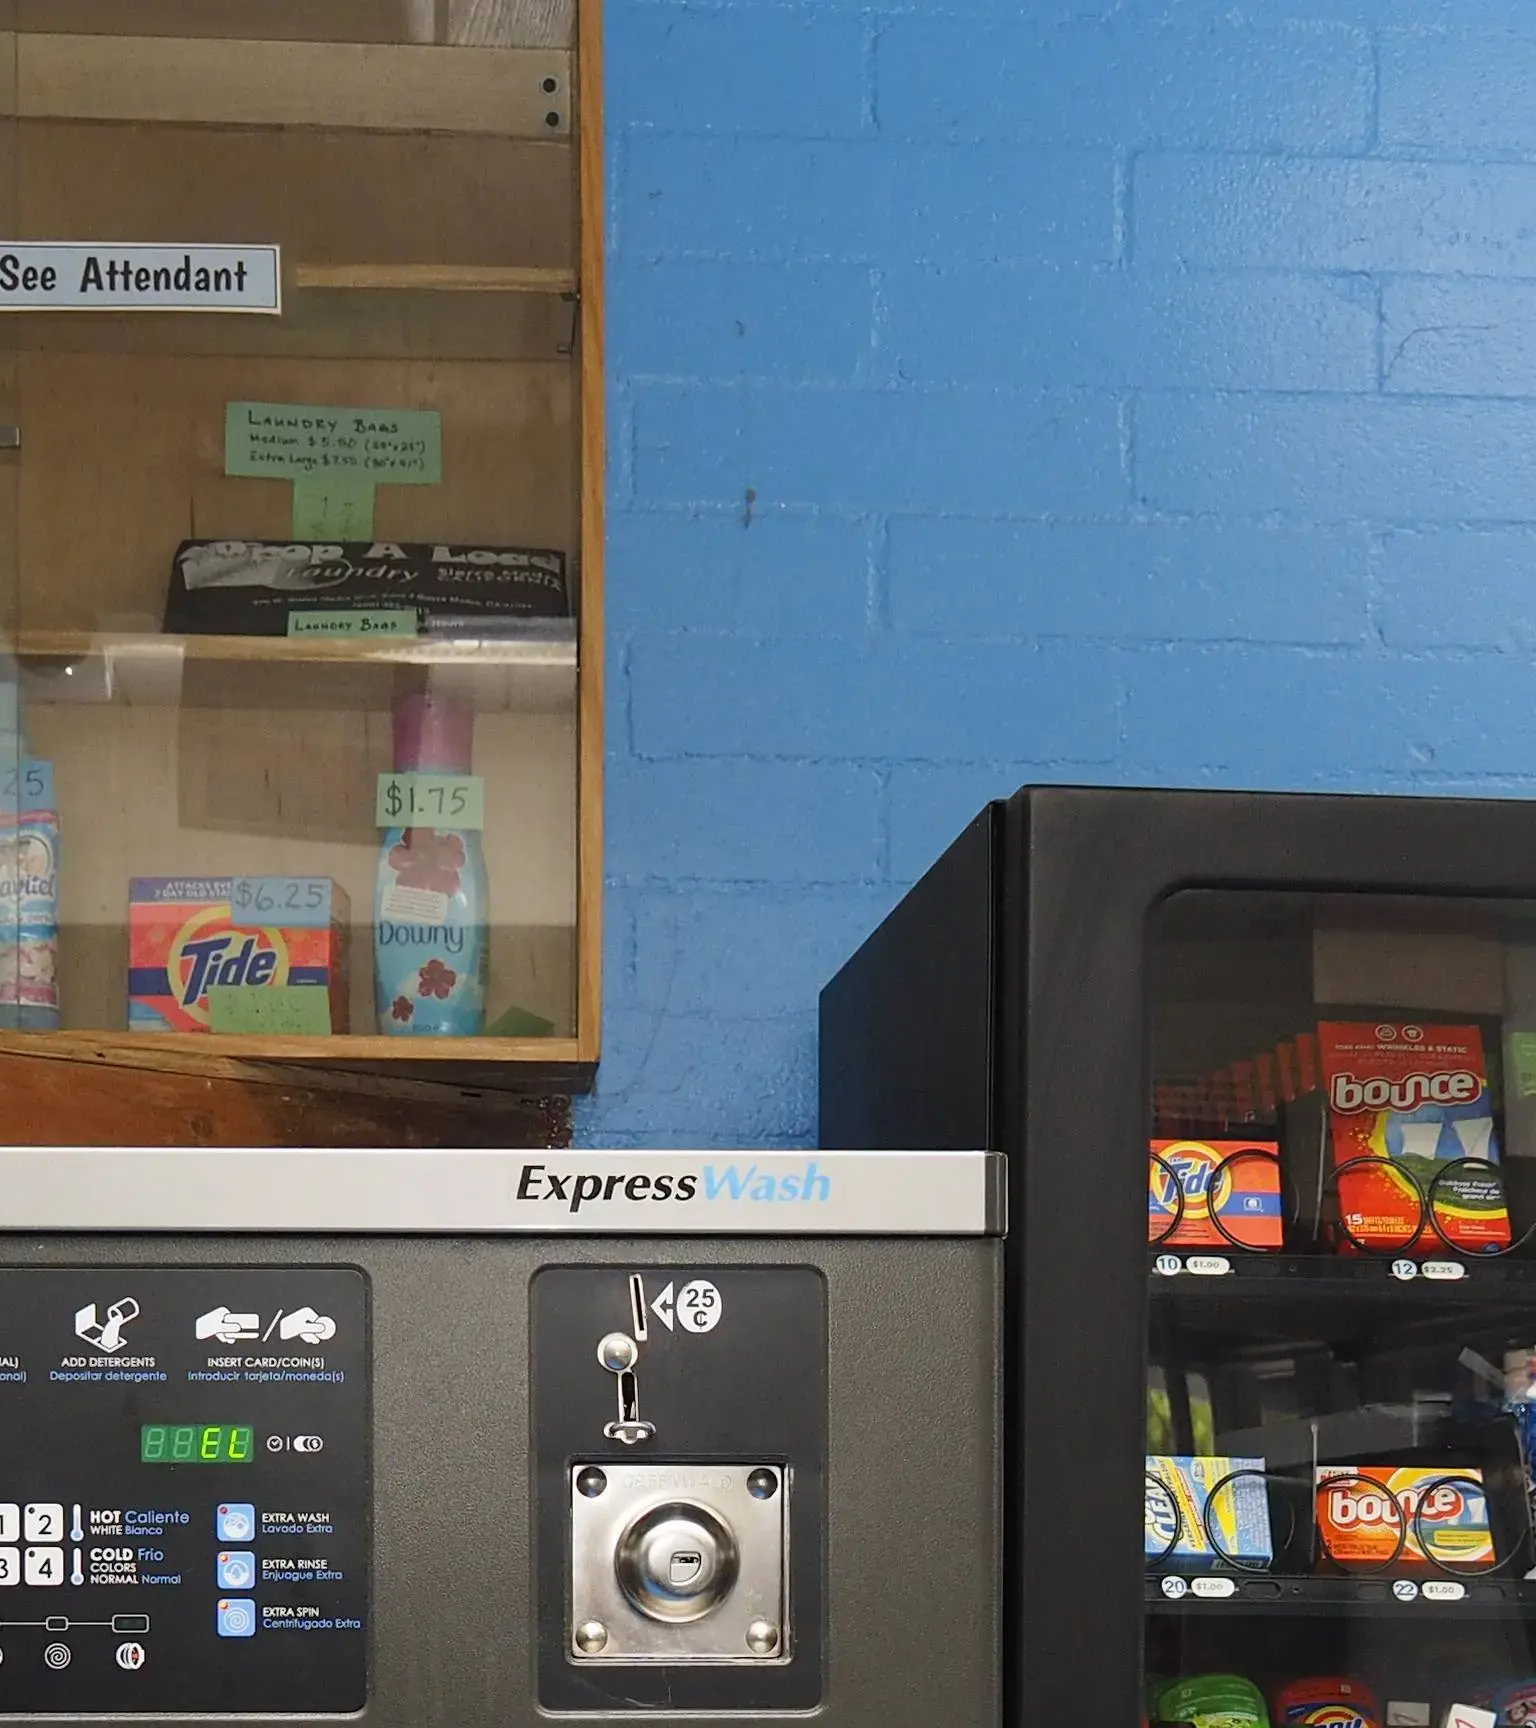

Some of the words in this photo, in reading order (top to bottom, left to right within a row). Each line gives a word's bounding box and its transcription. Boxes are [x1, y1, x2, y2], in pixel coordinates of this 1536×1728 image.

[80, 256, 247, 293] Attendant
[385, 780, 469, 817] $1.75
[235, 881, 328, 913] $6.25
[379, 922, 465, 954] Downy
[180, 934, 276, 1007] Tide
[1332, 1072, 1476, 1110] bounce
[1157, 1258, 1176, 1271] 10
[1395, 1263, 1413, 1275] 12
[685, 1288, 715, 1309] 25
[208, 1357, 242, 1368] INSERT
[90, 1510, 121, 1524] HOT
[125, 1510, 190, 1524] Caliente
[1331, 1487, 1460, 1526] bounce
[38, 1514, 52, 1536] 2
[262, 1513, 295, 1523] EXTRA
[298, 1513, 330, 1523] WASH
[90, 1549, 133, 1561] COLD
[38, 1558, 52, 1579] 4
[1165, 1579, 1185, 1593] 20
[1195, 1582, 1223, 1591] $1.00
[1396, 1583, 1415, 1596] 22
